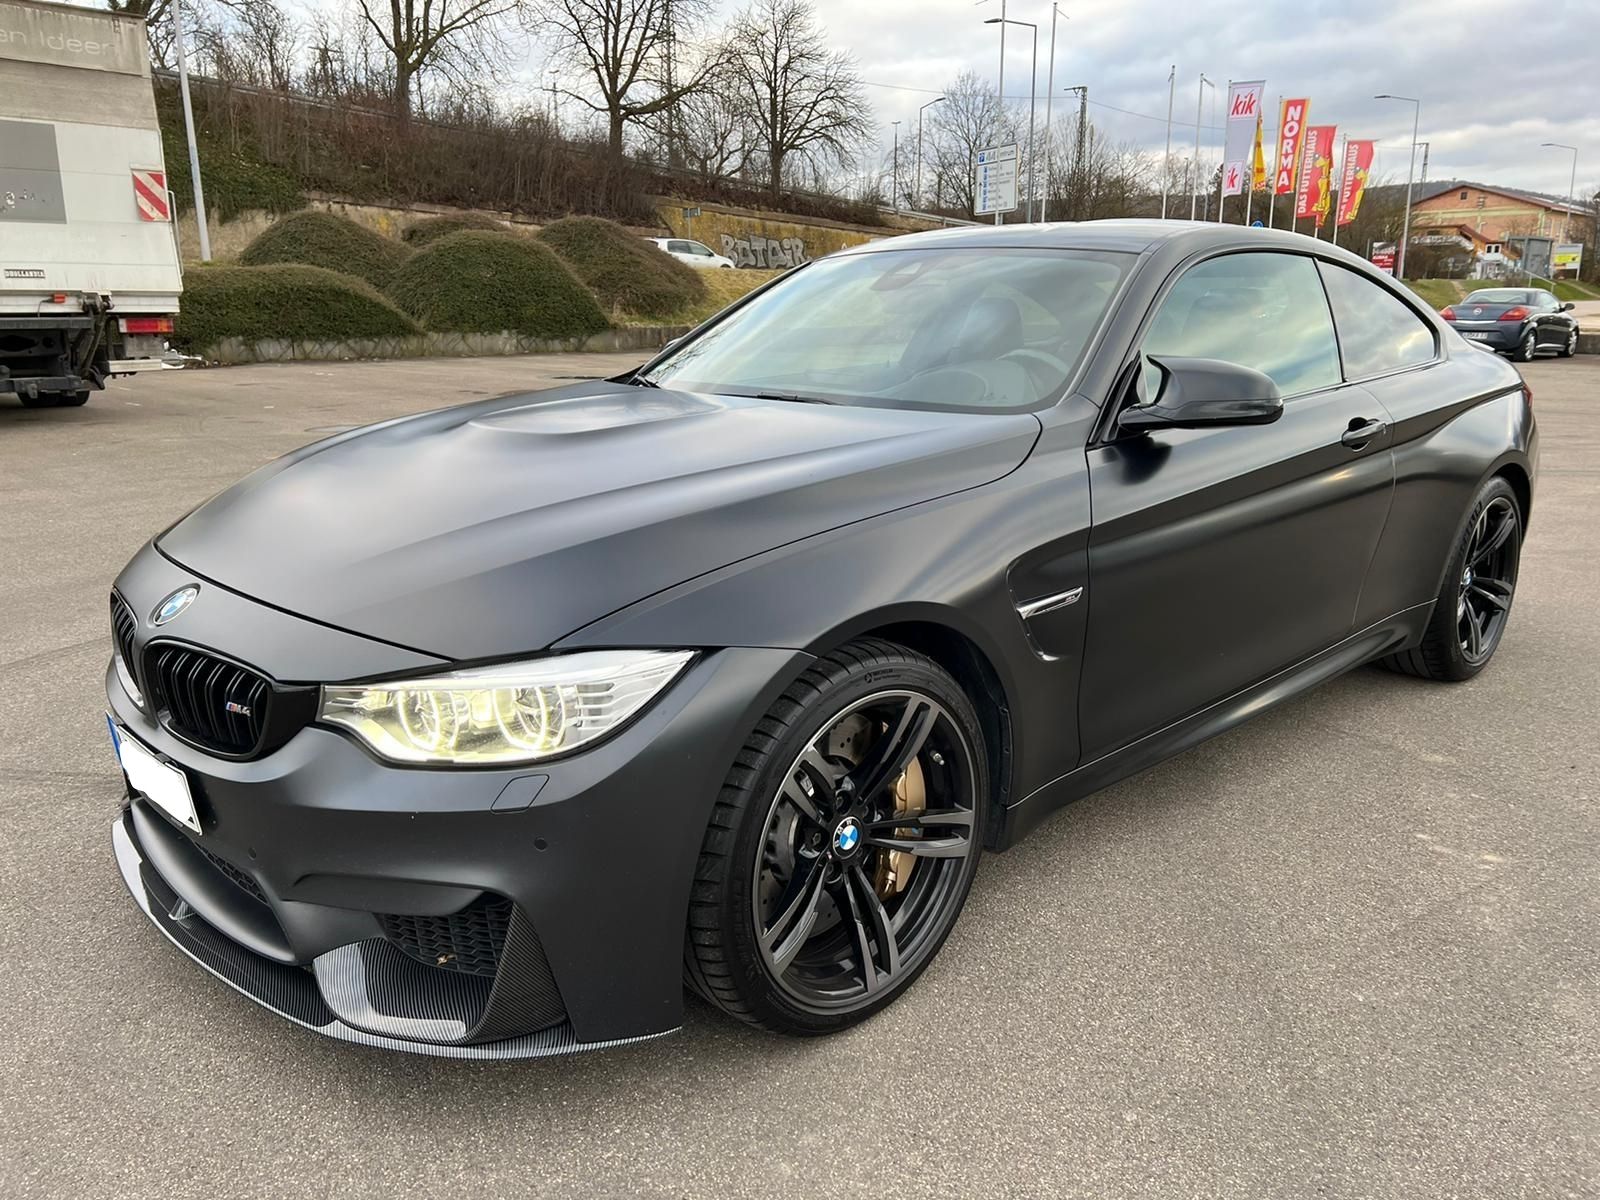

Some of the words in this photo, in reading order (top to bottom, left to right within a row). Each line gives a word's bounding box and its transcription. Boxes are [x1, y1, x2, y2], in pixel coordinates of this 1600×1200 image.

[1277, 105, 1302, 187] NORMA
[1300, 130, 1318, 193] FUTTERHAUS
[1297, 194, 1308, 214] DAS
